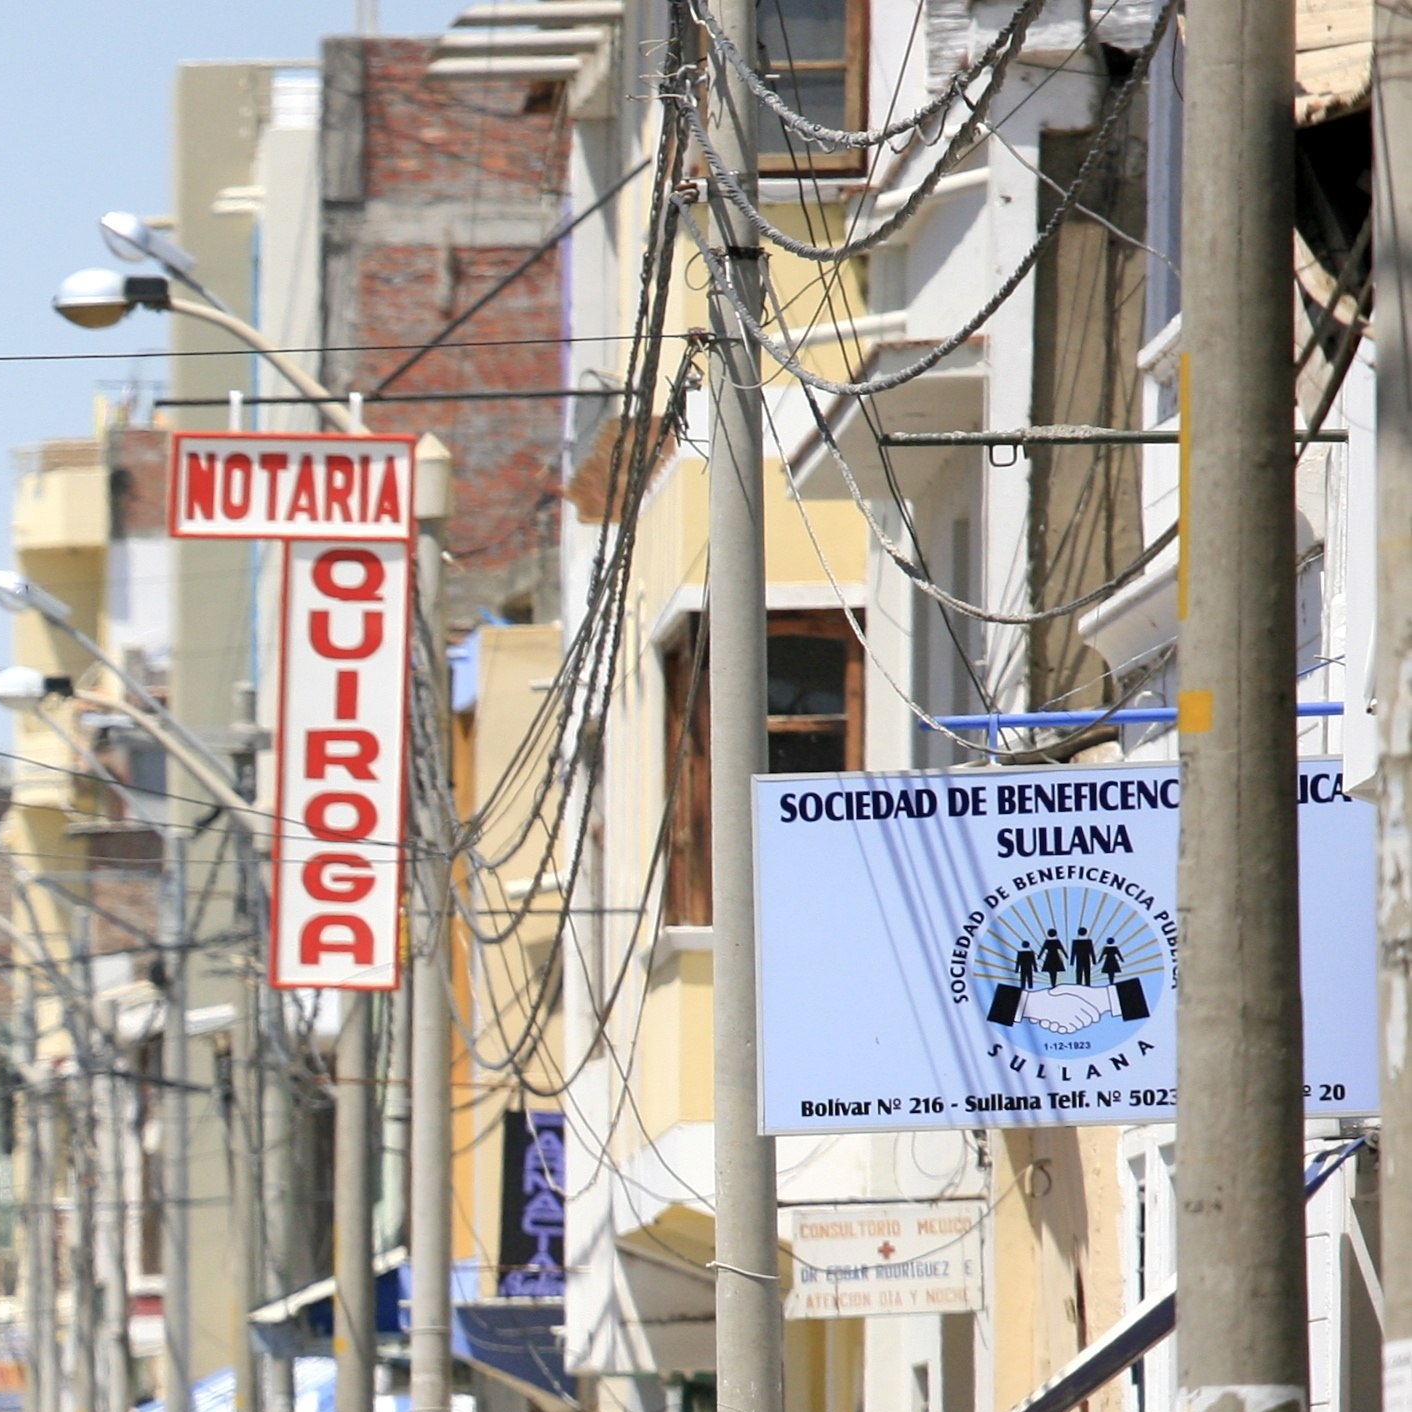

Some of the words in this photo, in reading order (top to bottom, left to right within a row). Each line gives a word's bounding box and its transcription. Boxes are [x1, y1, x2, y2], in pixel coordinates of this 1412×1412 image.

[186, 451, 400, 523] NOTARIA
[298, 548, 385, 967] QUIROGA
[780, 789, 938, 823] SOCIEDAD
[948, 785, 987, 818] DE
[998, 778, 1178, 815] BENEFICENC
[996, 825, 1134, 858] SULLANA
[950, 911, 986, 1004] SOCIEDAD
[984, 886, 1011, 909] DE
[1012, 865, 1156, 912] BENEFICENCIA
[986, 1039, 1156, 1082] SULLANA
[801, 1098, 872, 1118] Bolívar
[908, 1096, 945, 1115] 216
[964, 1092, 1042, 1113] Sullana
[1049, 1089, 1090, 1111] Telf.
[1319, 1084, 1347, 1102] 20
[799, 1219, 901, 1240] CONSULTORIO
[909, 1288, 918, 1306] Y
